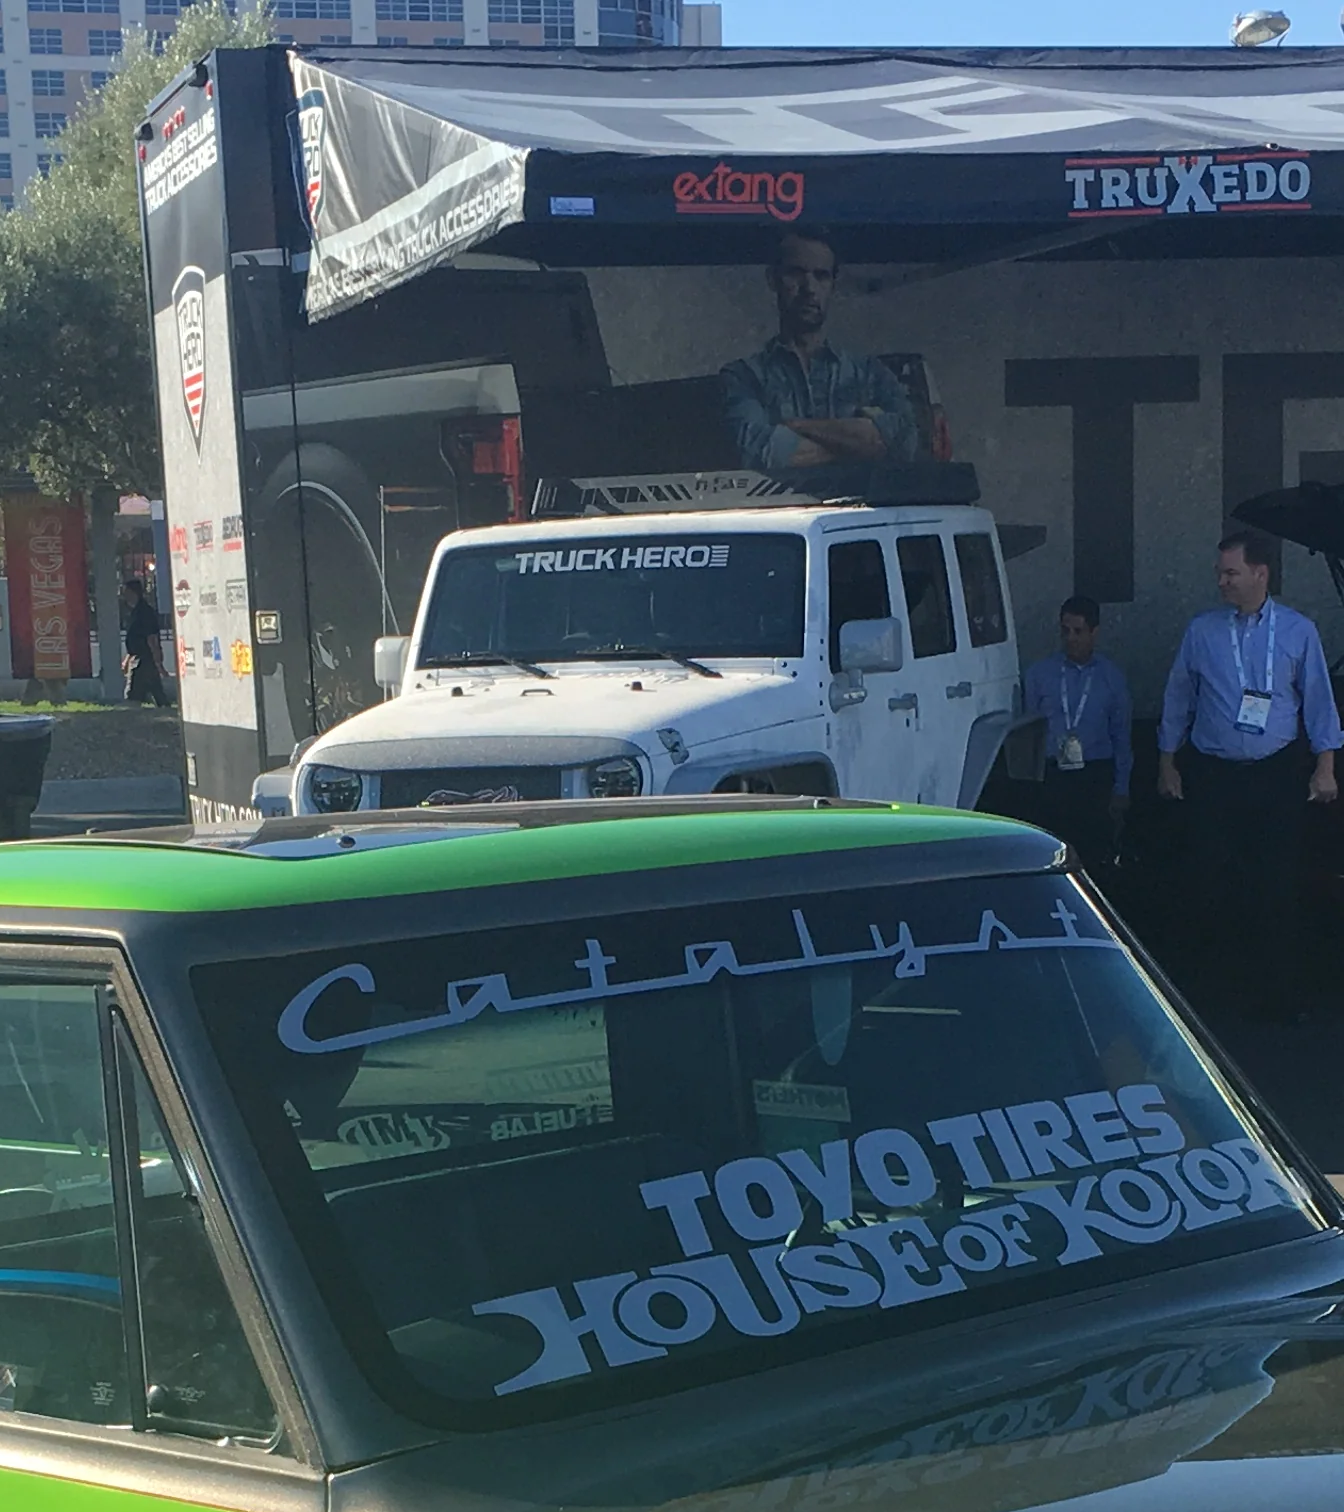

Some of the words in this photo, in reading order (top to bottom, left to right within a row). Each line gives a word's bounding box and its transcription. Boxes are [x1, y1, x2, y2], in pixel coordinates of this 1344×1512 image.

[405, 223, 442, 264] TRUCK
[439, 173, 521, 244] ACCESSORIES
[673, 161, 804, 221] extang
[29, 516, 67, 609] VEGAS
[515, 548, 618, 575] TRUCK
[34, 616, 70, 671] LAS
[277, 899, 1132, 1054] Catalyst
[639, 1128, 937, 1257] TOYO
[927, 1084, 1186, 1189] TIRES
[472, 1217, 967, 1397] HOUSE
[1014, 1137, 1313, 1265] KOLOR
